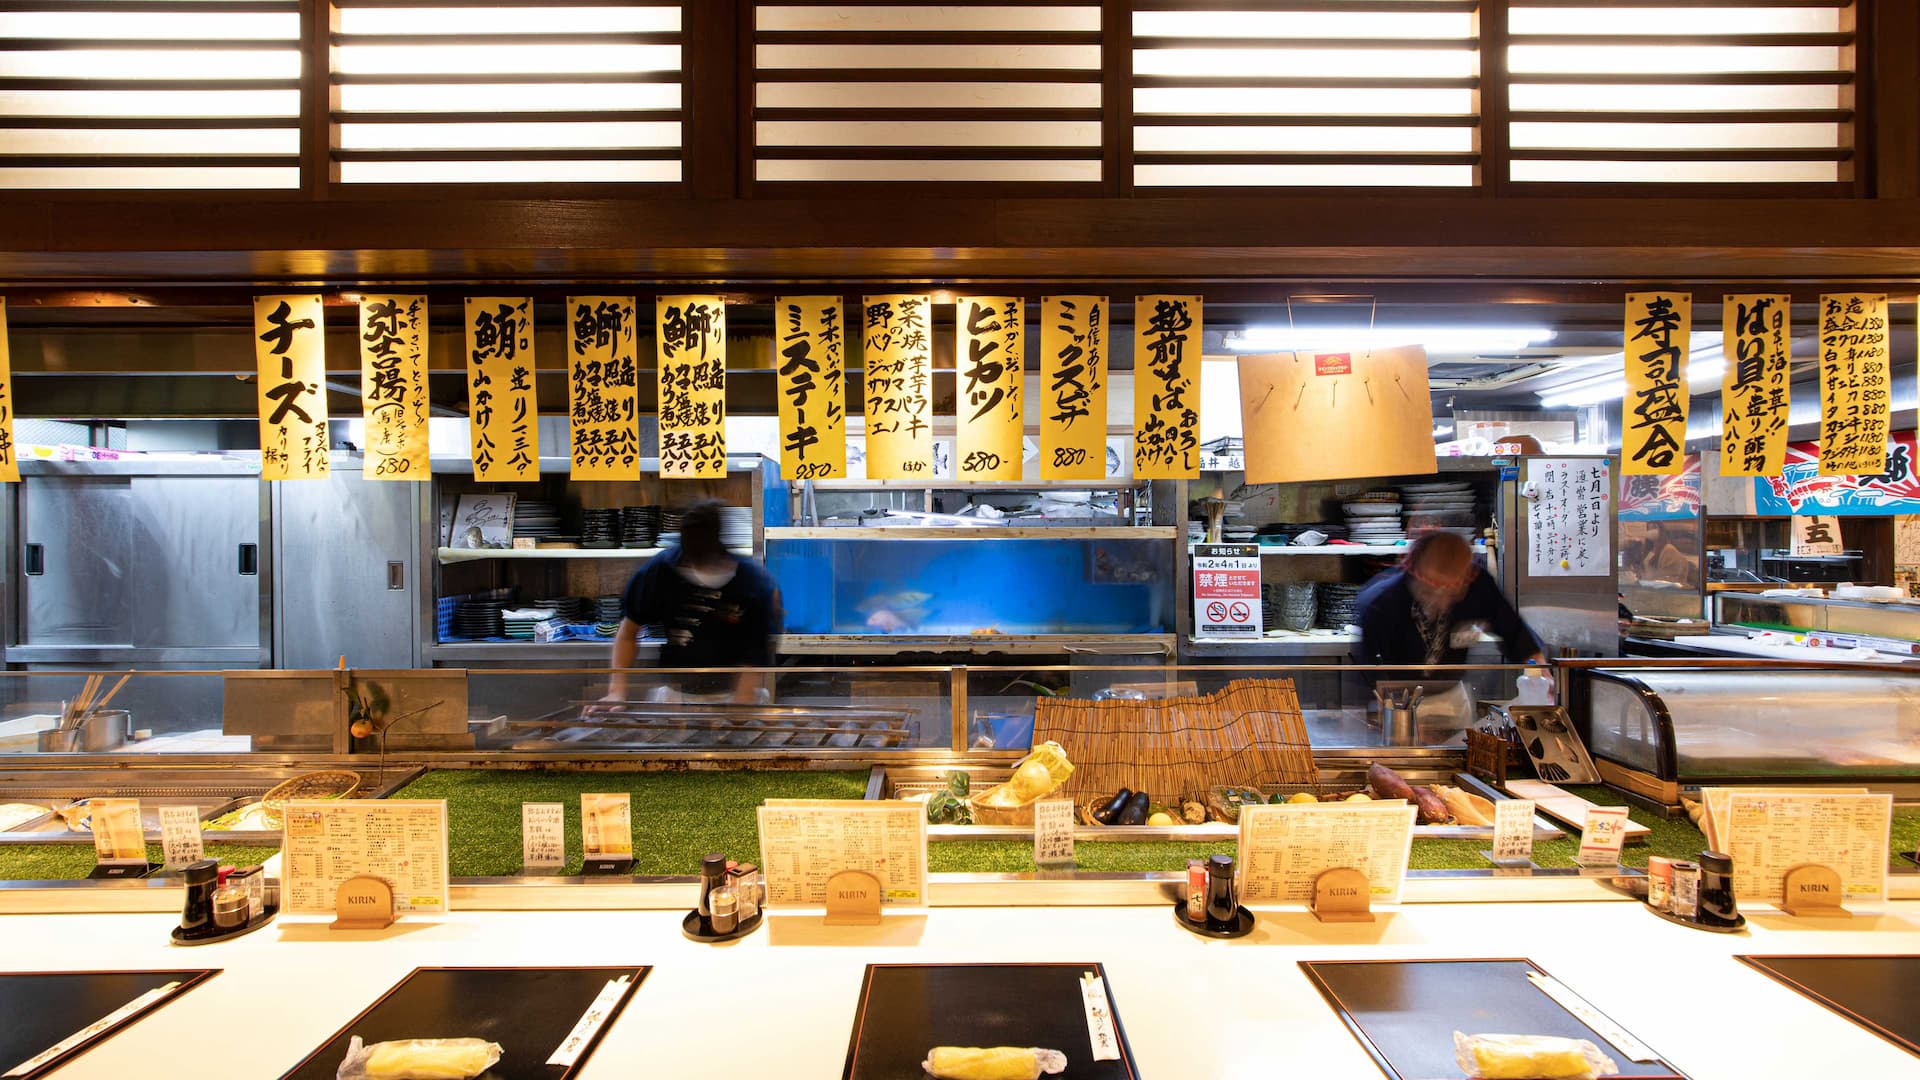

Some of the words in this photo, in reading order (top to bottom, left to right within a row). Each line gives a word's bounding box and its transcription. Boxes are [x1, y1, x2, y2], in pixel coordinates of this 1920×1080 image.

[621, 306, 635, 343] ブリ
[1825, 297, 1878, 316] お造り
[472, 303, 517, 365] 鮪
[516, 302, 530, 350] マグロ
[574, 301, 622, 358] 鰤
[662, 302, 712, 360] 鰤
[711, 307, 725, 344] ブリ
[259, 300, 319, 425] チーズ
[1049, 300, 1091, 432] ミックスピザ
[1142, 299, 1192, 411] 越前そば
[1731, 298, 1776, 398] ばい貝
[779, 304, 821, 462] ミニステーキ
[1631, 296, 1685, 468] 寿司盛合
[1826, 375, 1860, 391] 甘エビ
[1827, 391, 1858, 404] イカ
[868, 395, 928, 416] アスパラ
[1827, 405, 1859, 419] タコ
[870, 414, 929, 440] エノキ
[1145, 413, 1165, 466] 山かけ
[1179, 408, 1198, 471] おろし
[302, 436, 312, 474] フライ
[903, 461, 927, 472] ほか
[1590, 466, 1601, 538] 七月一日より
[1210, 547, 1241, 556] お知らせ
[1199, 573, 1228, 588] 禁煙
[348, 895, 376, 905] KIRIN
[839, 890, 867, 900] KIRIN
[1329, 887, 1358, 897] KIRIN
[1800, 884, 1829, 893] KIRIN
